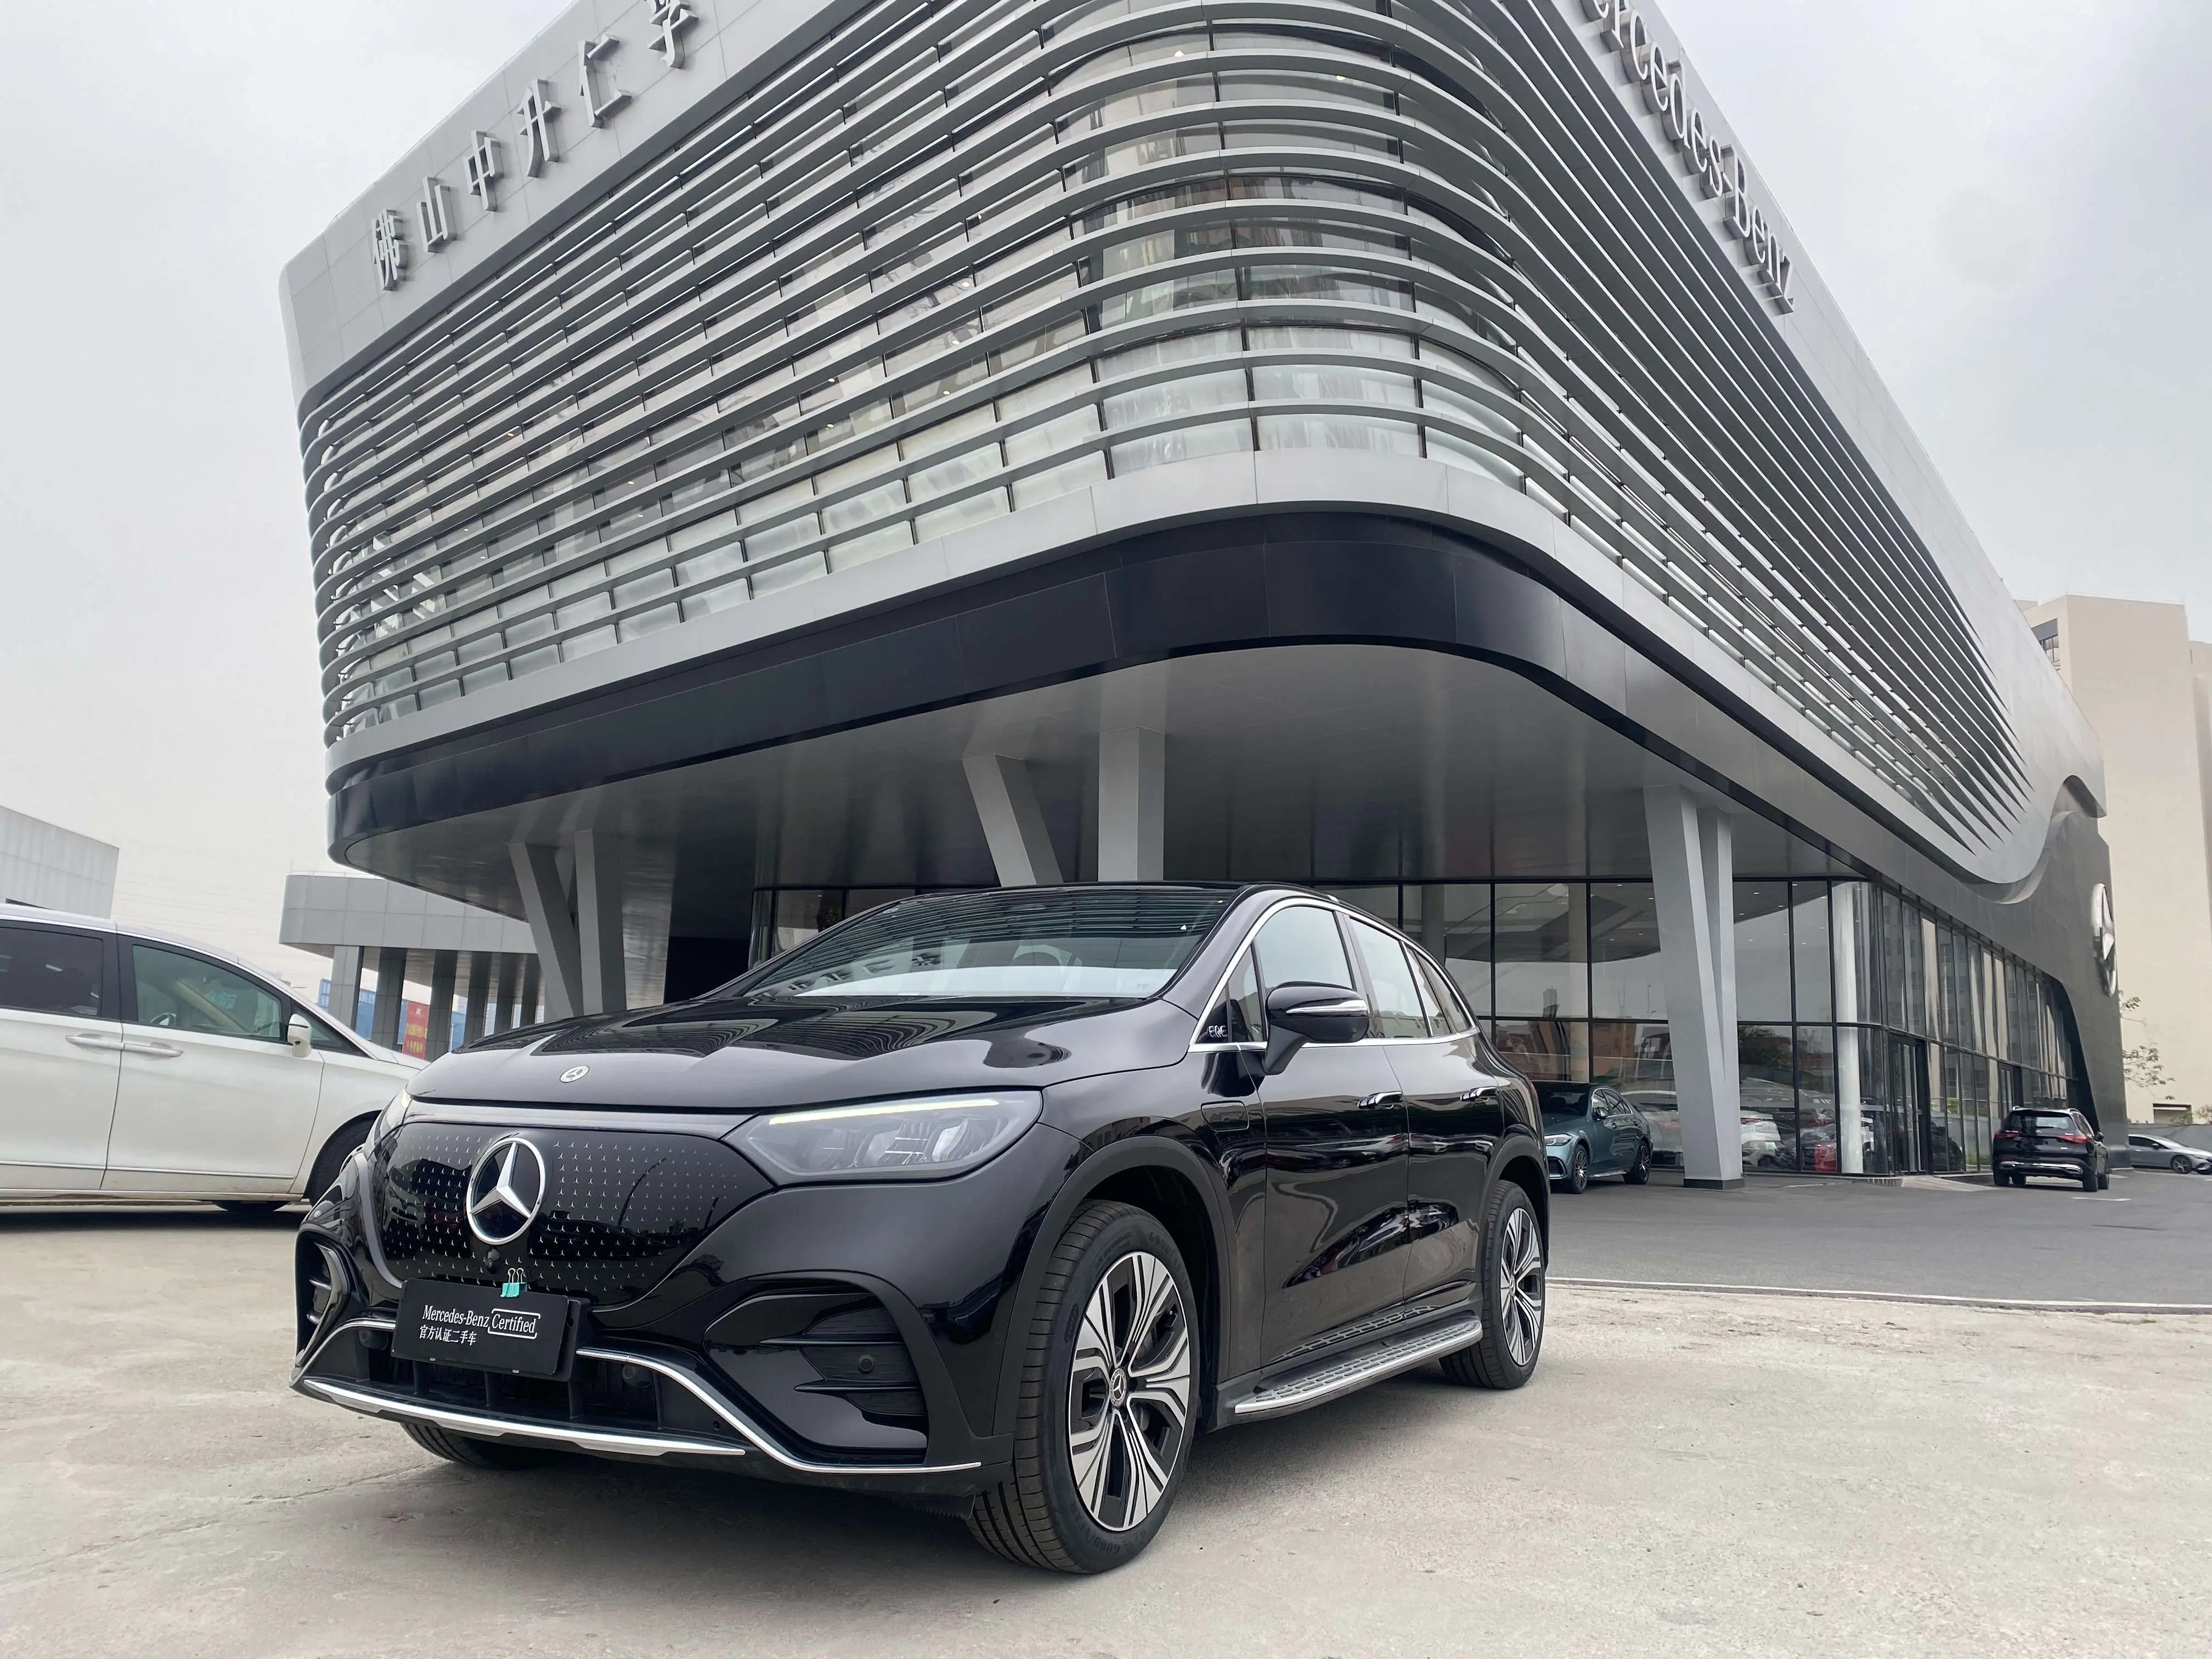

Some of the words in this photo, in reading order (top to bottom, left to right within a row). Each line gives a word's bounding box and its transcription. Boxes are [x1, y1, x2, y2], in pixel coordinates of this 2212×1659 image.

[1580, 0, 1794, 313] rcedes-Benz
[1209, 1025, 1228, 1038] EQE
[422, 1305, 490, 1328] Mercedes-Benz
[492, 1313, 535, 1334] Certified
[419, 1324, 477, 1346] 官方认证二手车
